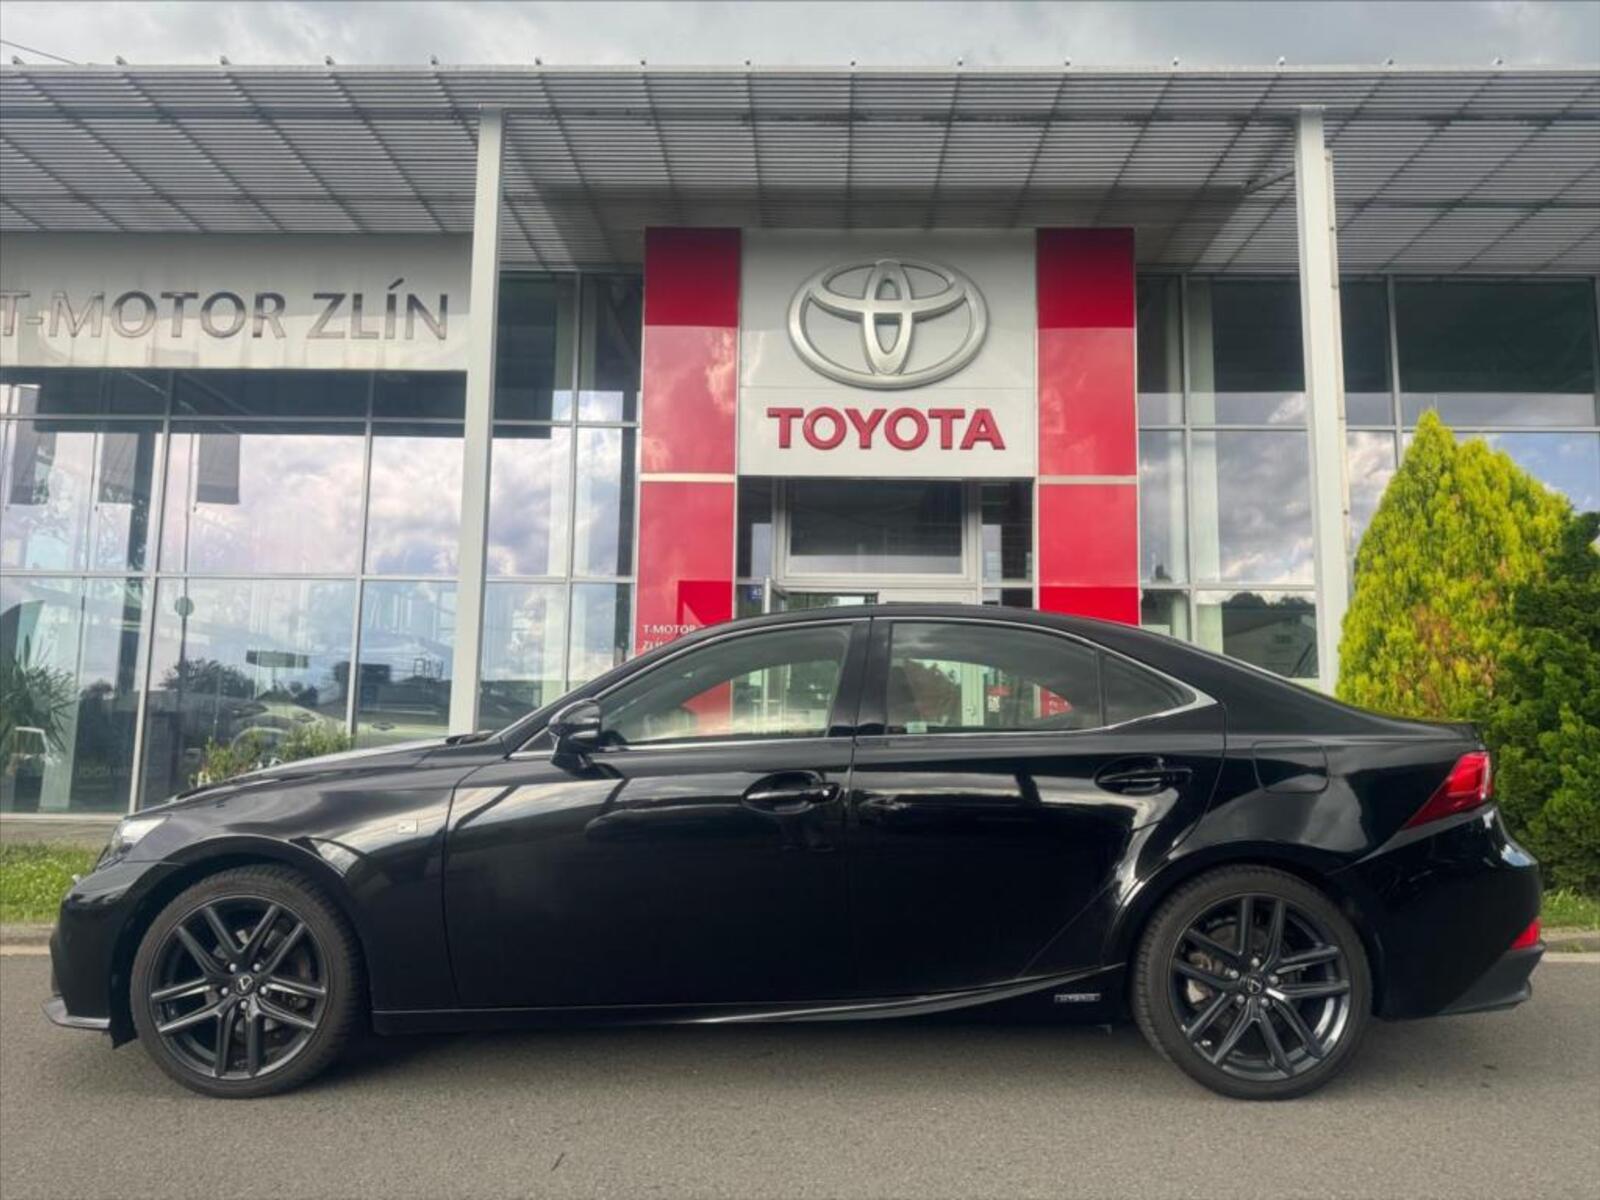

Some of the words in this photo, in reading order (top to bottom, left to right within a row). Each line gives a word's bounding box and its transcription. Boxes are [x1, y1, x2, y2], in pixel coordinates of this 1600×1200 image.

[0, 289, 287, 338] T-MOTOR
[306, 277, 448, 340] ZLÍN
[766, 406, 1006, 451] TOYOTA
